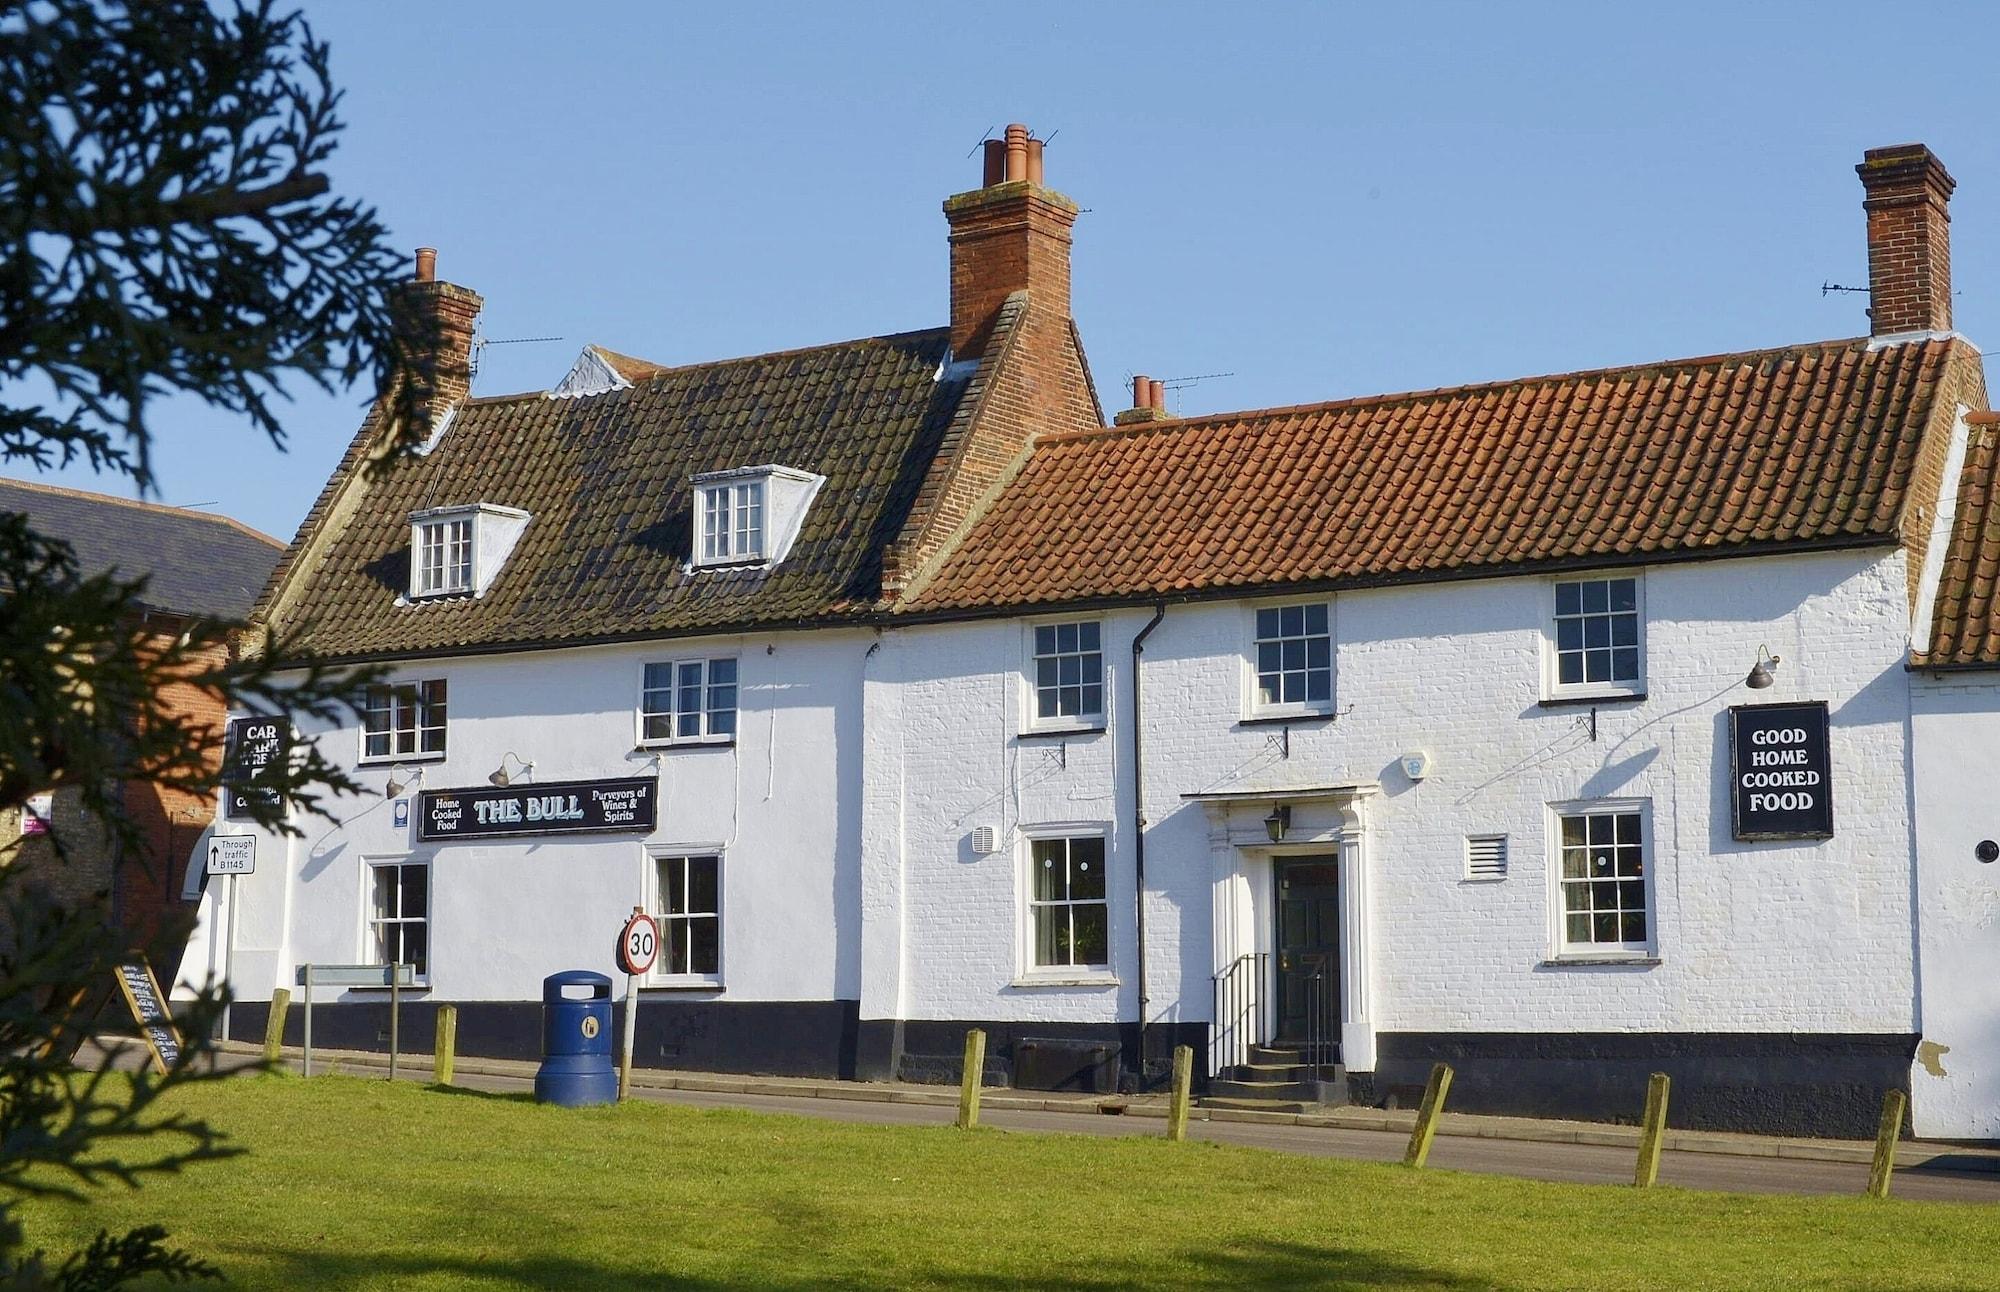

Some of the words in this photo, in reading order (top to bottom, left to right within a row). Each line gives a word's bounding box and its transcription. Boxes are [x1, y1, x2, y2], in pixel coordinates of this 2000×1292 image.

[246, 725, 277, 739] CAR
[1752, 728, 1807, 745] GOOD
[1752, 749, 1808, 766] HOME
[1742, 770, 1820, 788] COOKED
[591, 788, 636, 802] Purveyors
[636, 786, 647, 797] of
[435, 798, 460, 809] Home
[601, 799, 628, 811] Wines
[628, 797, 638, 809] &
[1750, 792, 1814, 811] FOOD
[431, 808, 462, 821] Cooked
[473, 798, 523, 825] THE
[526, 795, 584, 821] BULL
[604, 810, 635, 824] Spirits
[436, 819, 457, 831] Food
[221, 840, 253, 850] Through
[224, 850, 249, 859] traffic
[630, 933, 653, 956] 30
